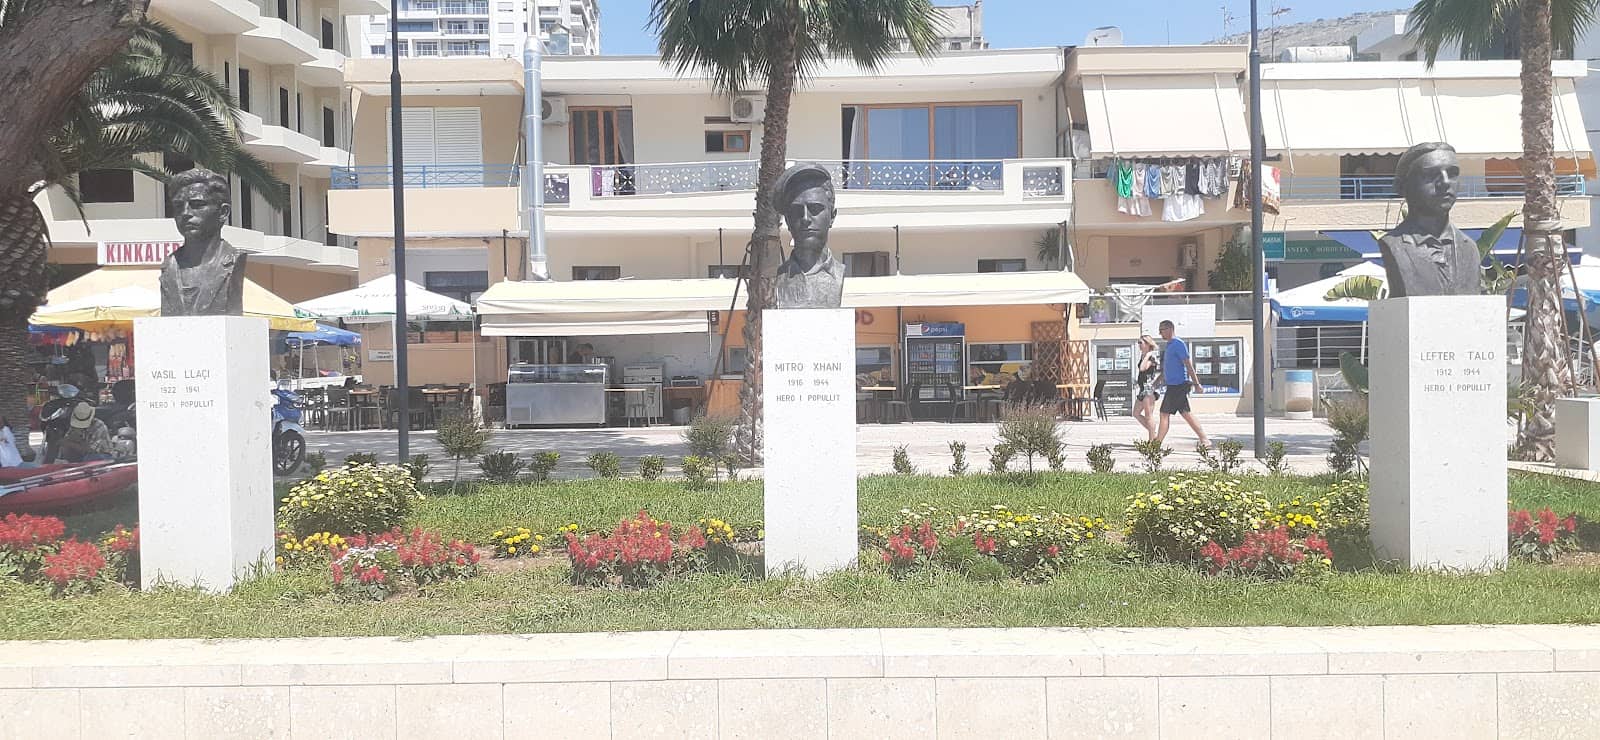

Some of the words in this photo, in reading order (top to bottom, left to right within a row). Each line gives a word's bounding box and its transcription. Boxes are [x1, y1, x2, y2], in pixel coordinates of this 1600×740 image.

[1420, 351, 1455, 361] LEFTER
[1467, 351, 1495, 361] TALO
[775, 362, 804, 372] MITRO
[813, 362, 842, 372] XHANI
[151, 370, 177, 379] VASIL
[184, 369, 210, 380] LLAÇI
[1436, 368, 1452, 376] 1912
[1463, 368, 1480, 376] 1944
[813, 378, 829, 386] 1944
[160, 386, 177, 394] 1922
[185, 385, 200, 393] 1941
[1424, 384, 1445, 392] HERO
[1456, 384, 1491, 392] POPULLIT
[776, 394, 795, 402] HERO
[807, 394, 840, 402] POPULLIT
[149, 401, 168, 409] HERO
[180, 400, 214, 409] POPULLIT
